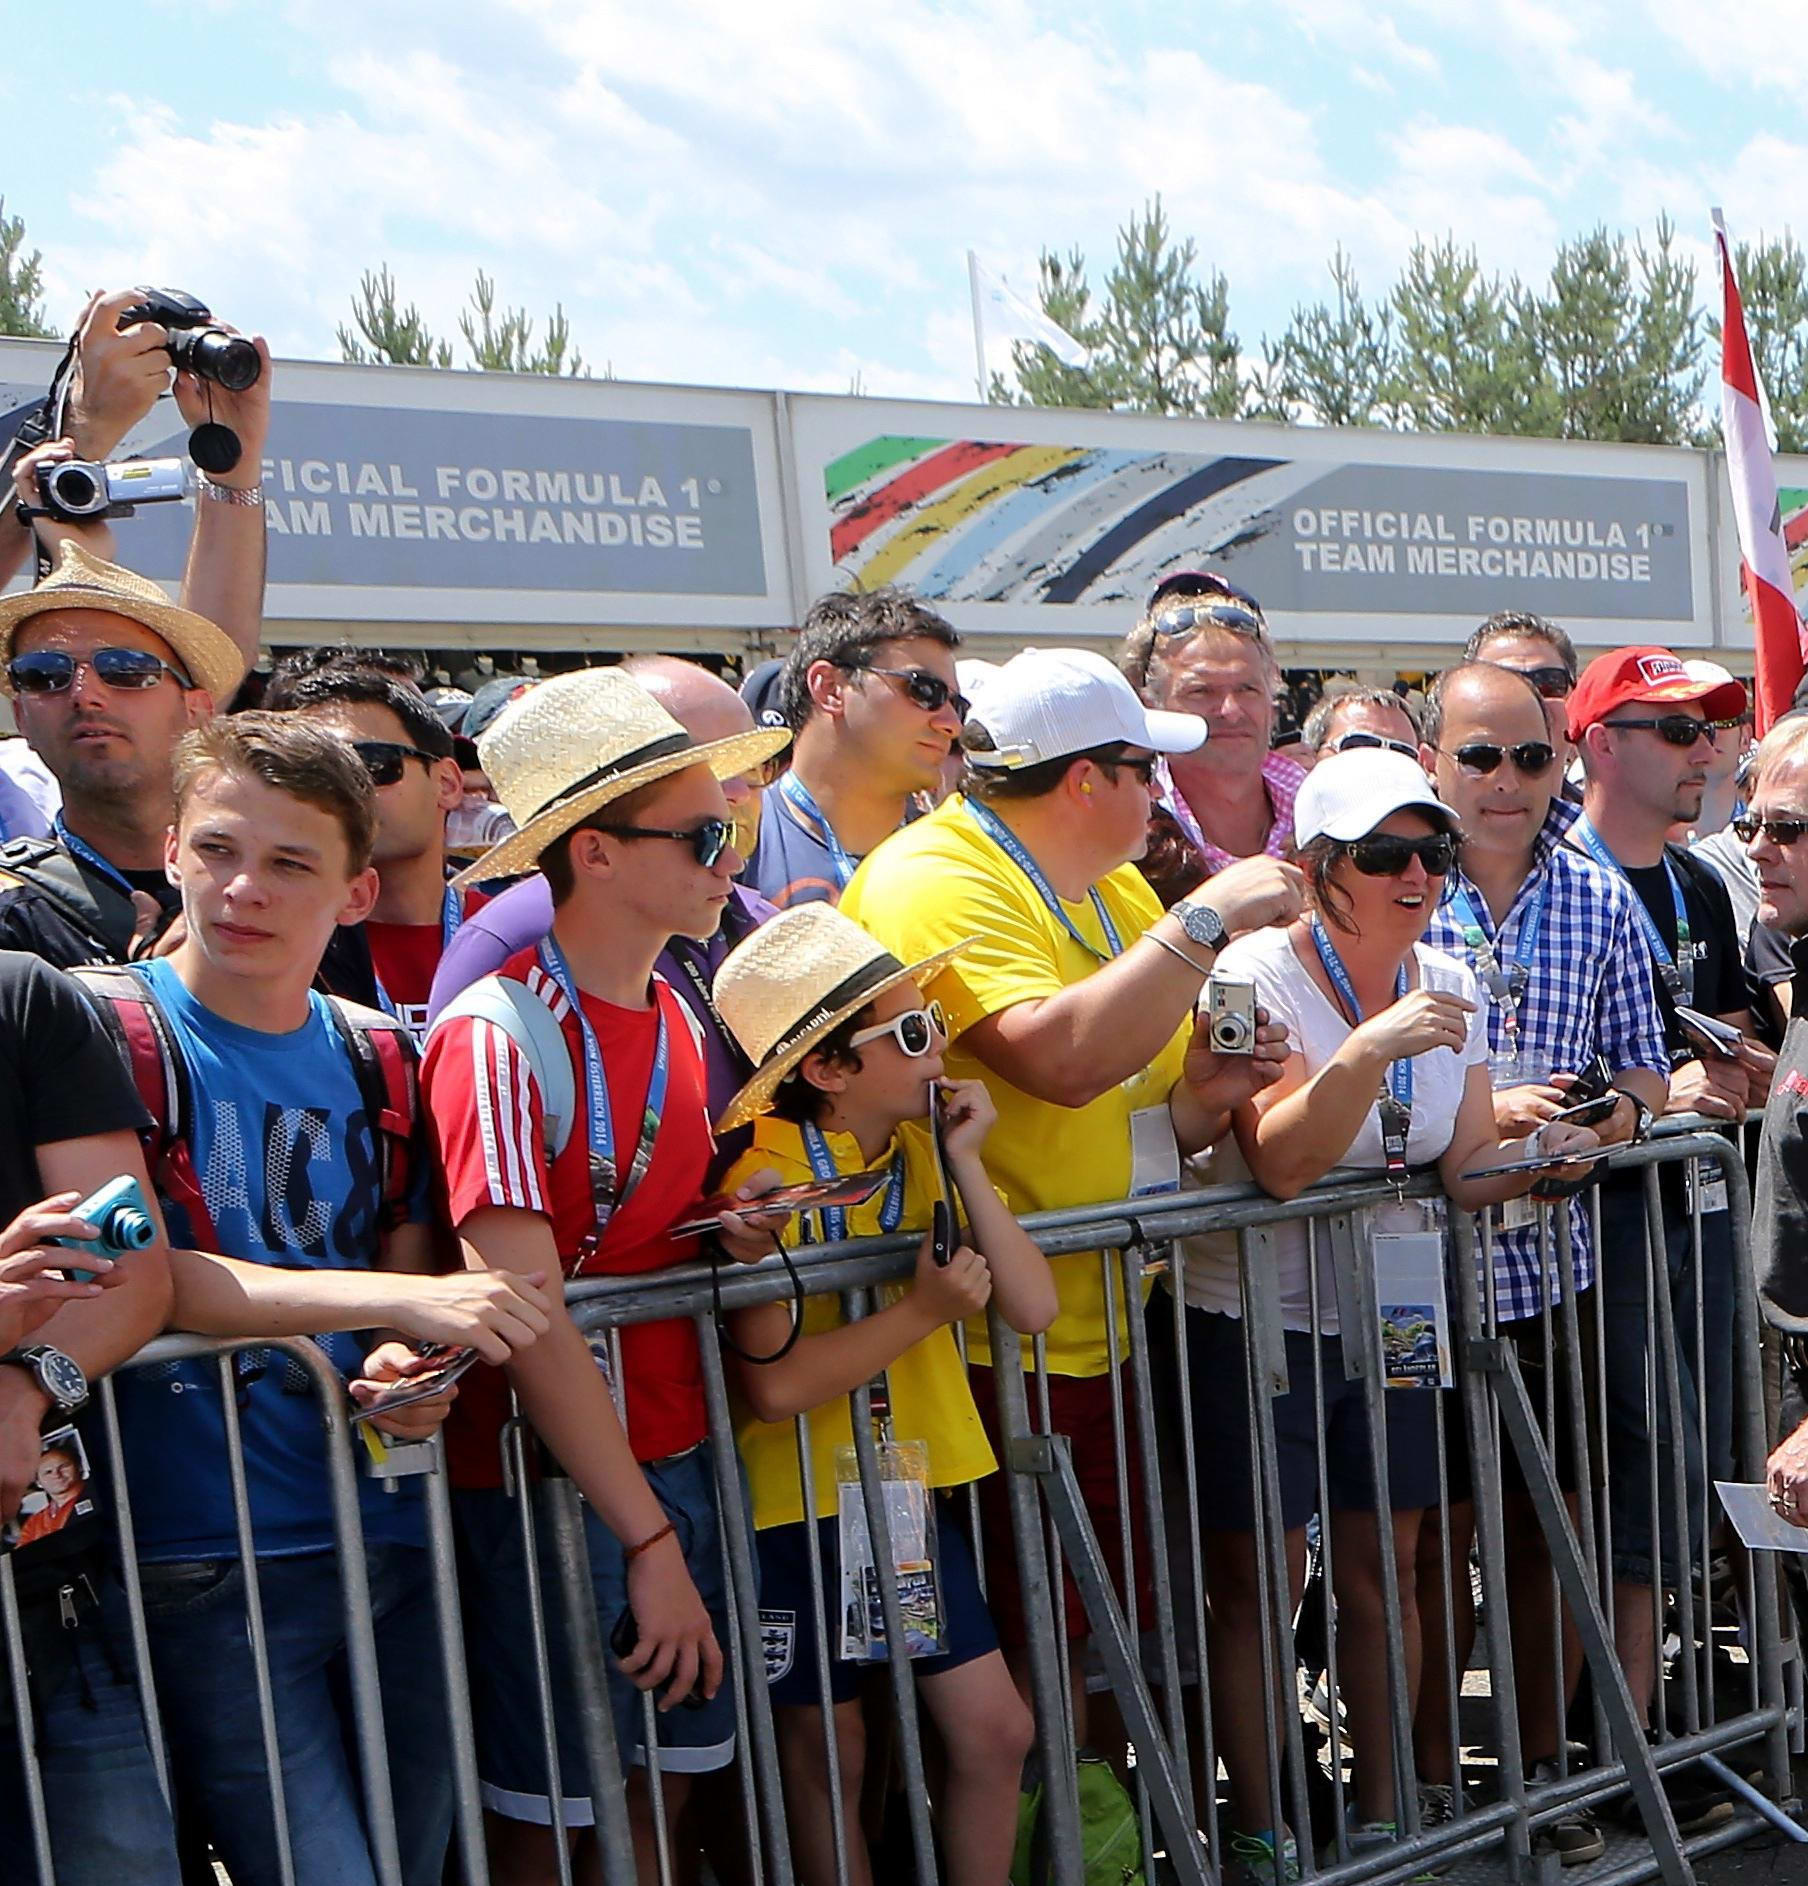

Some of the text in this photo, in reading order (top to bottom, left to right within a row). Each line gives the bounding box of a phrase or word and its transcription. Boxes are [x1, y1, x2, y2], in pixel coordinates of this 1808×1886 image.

[436, 466, 669, 508] FORMULA
[348, 502, 705, 549] MERCHANDISE
[1293, 508, 1456, 542] OFFICIAL
[1468, 516, 1627, 548] FORMULA
[1294, 542, 1652, 581] TEAM MERCHANDISE
[594, 1121, 607, 1145] 2014
